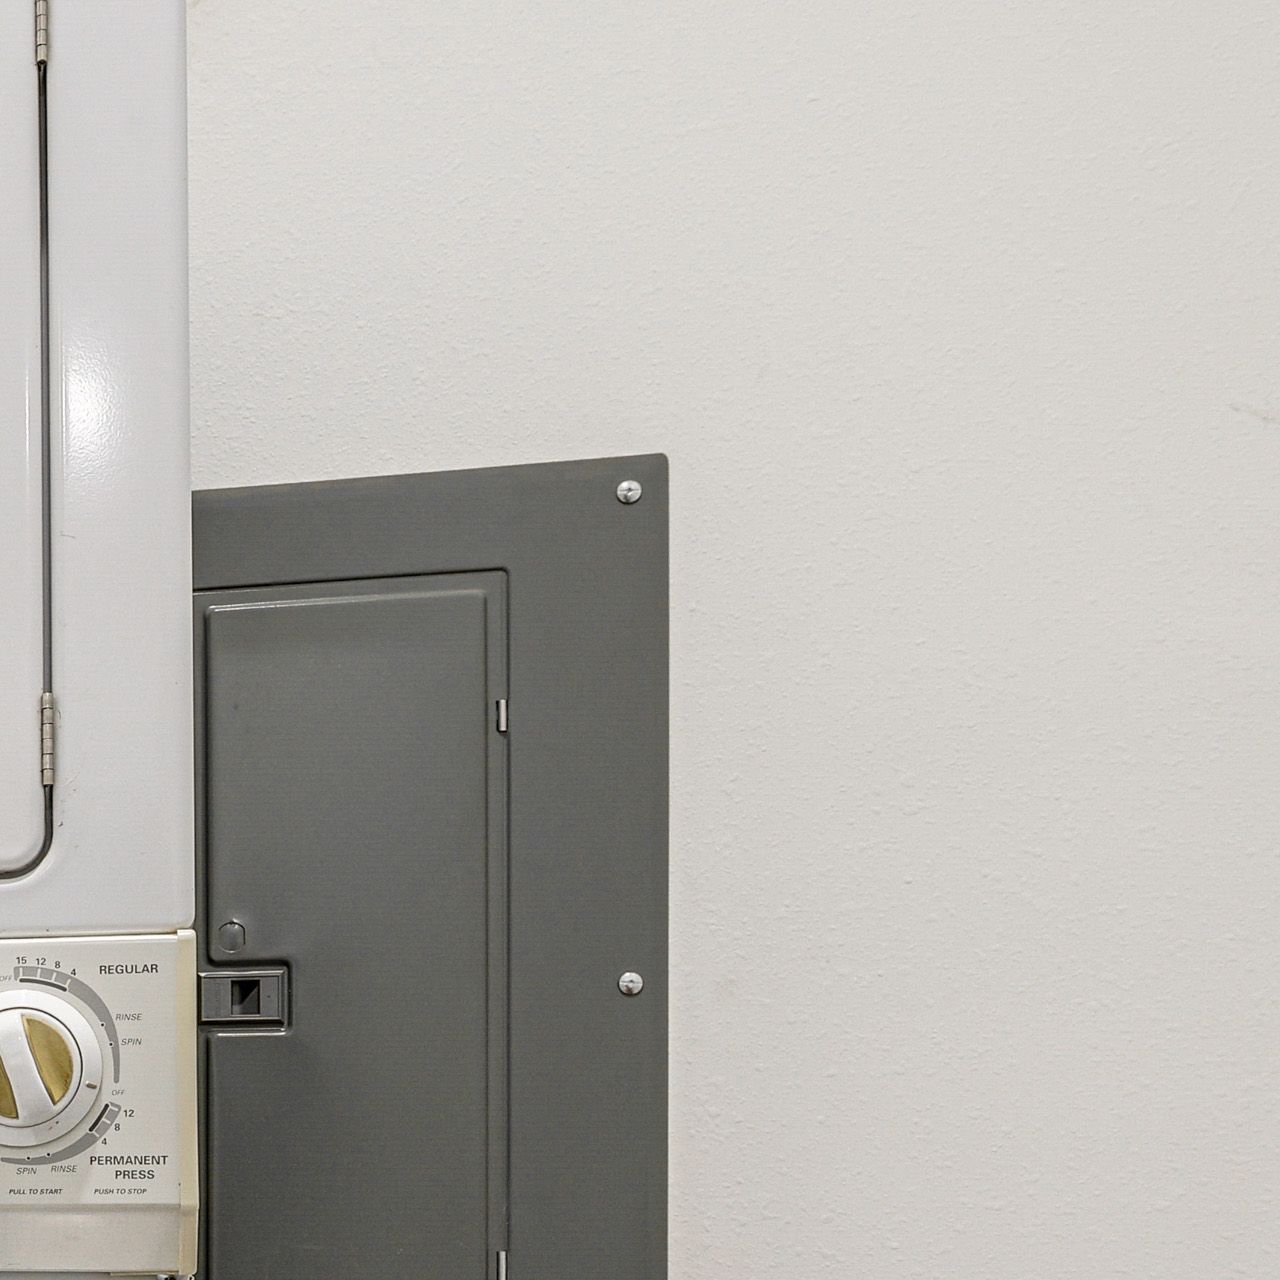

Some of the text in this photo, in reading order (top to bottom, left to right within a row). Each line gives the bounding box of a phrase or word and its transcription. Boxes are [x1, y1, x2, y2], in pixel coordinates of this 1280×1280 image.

[16, 957, 27, 965] 15
[36, 957, 46, 965] 12
[71, 968, 76, 976] 4
[99, 964, 159, 974] REGULAR
[115, 1013, 142, 1021] RINSE
[123, 1110, 134, 1118] 12
[114, 1123, 120, 1131] 8
[90, 1155, 168, 1166] PERMANENT
[16, 1167, 37, 1175] SPIN
[50, 1165, 77, 1173] RINSE
[115, 1170, 155, 1180] PRESS
